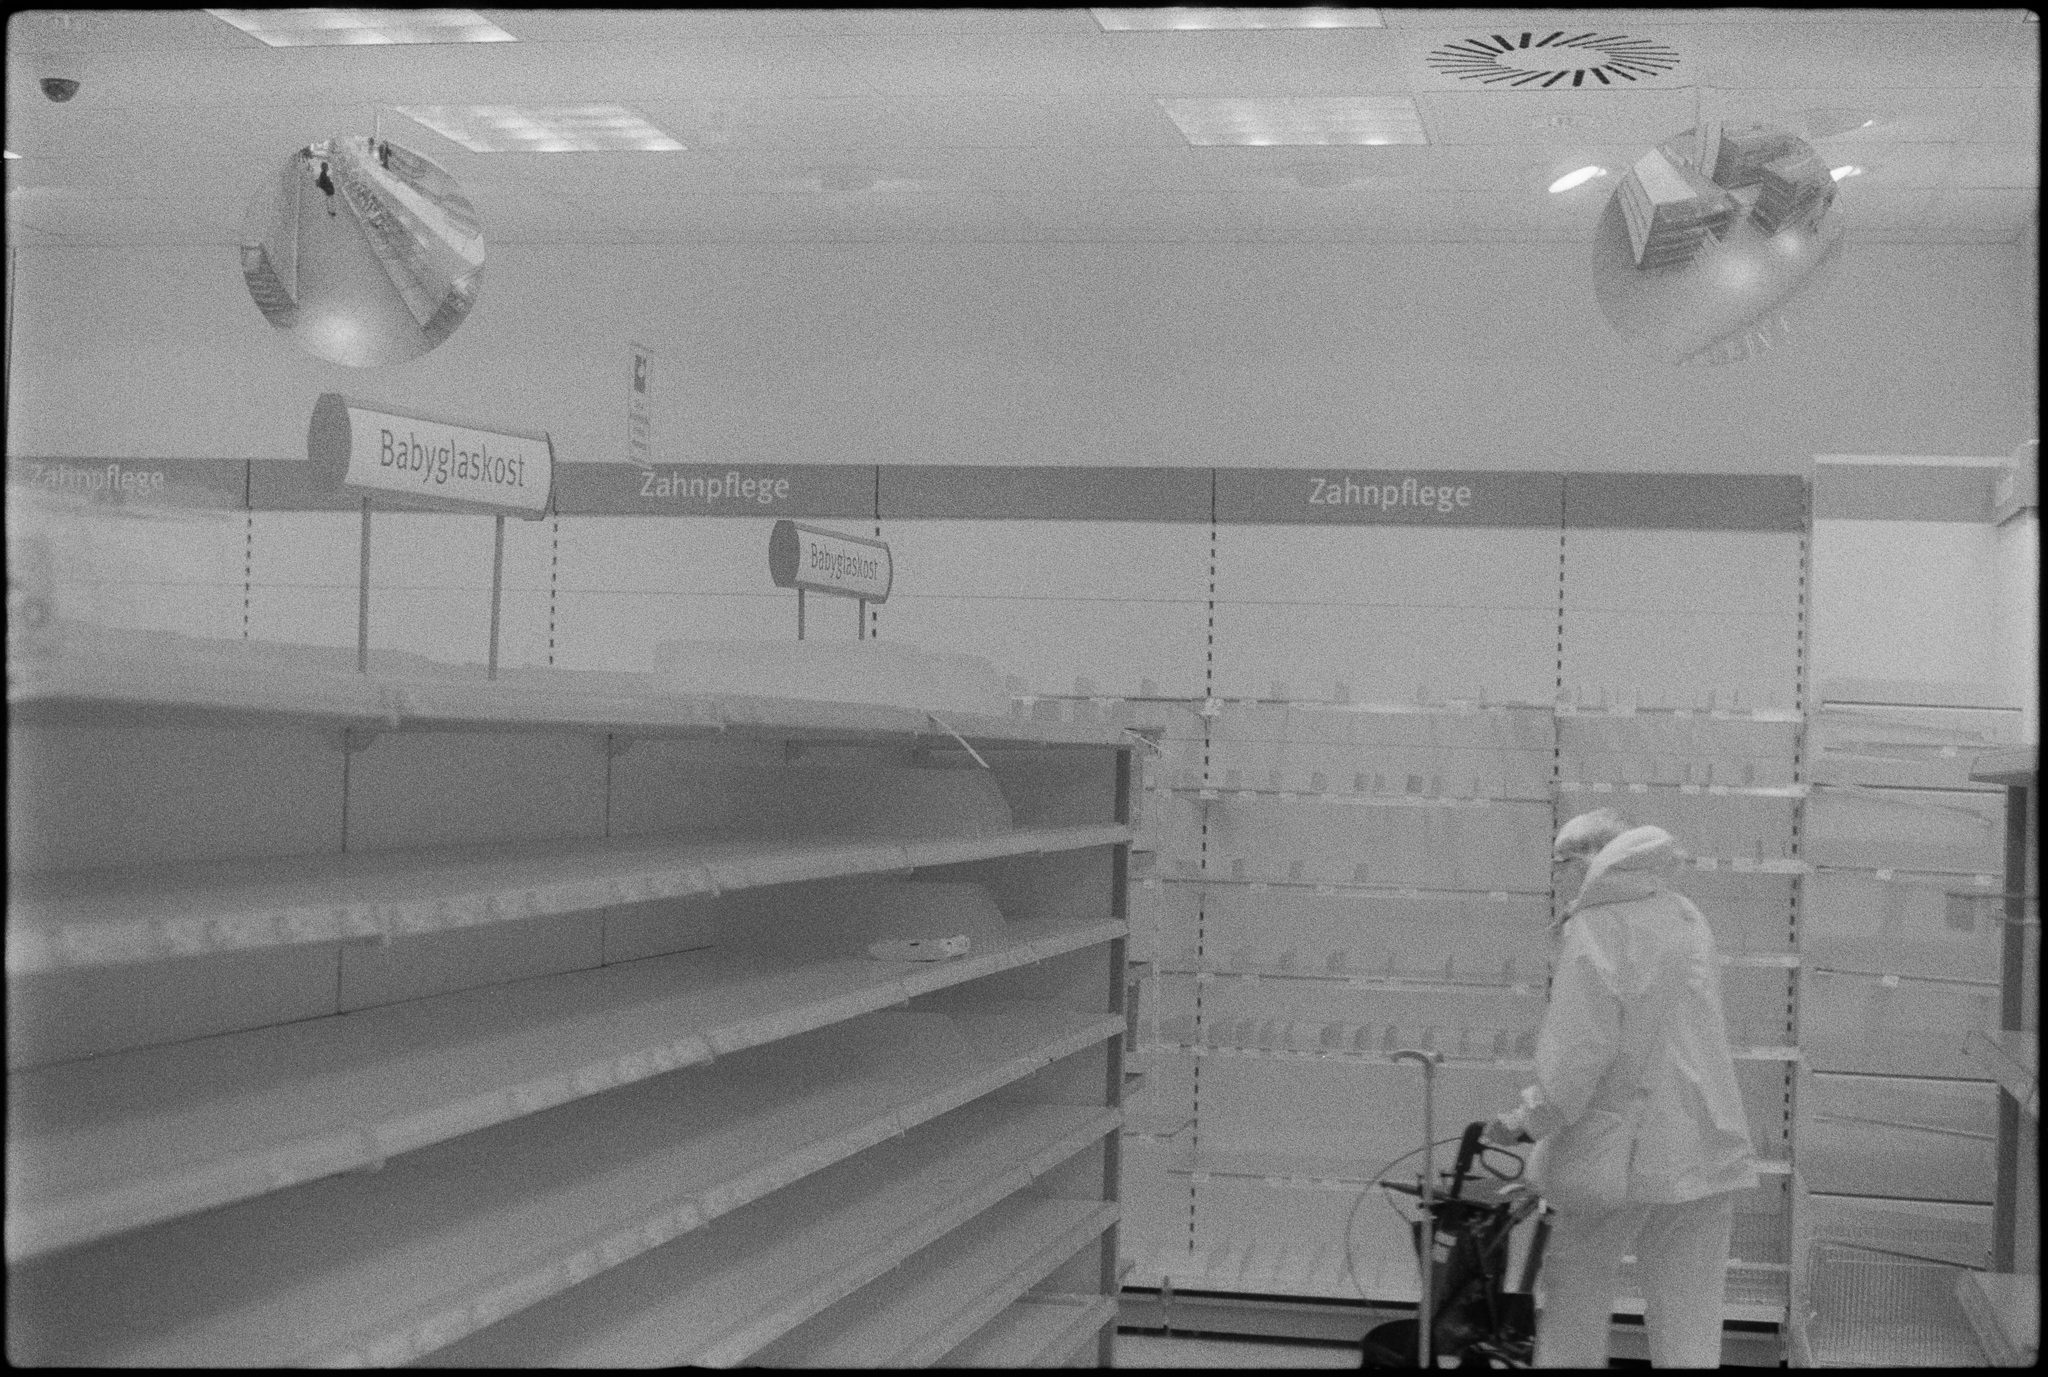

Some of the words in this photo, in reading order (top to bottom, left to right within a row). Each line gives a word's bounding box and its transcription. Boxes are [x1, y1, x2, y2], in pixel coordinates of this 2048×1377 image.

[380, 429, 525, 487] Babyglaskost
[639, 470, 790, 504] Zahnpflege
[1309, 476, 1472, 512] Zahnpflege
[811, 542, 878, 580] Babyglaskost
